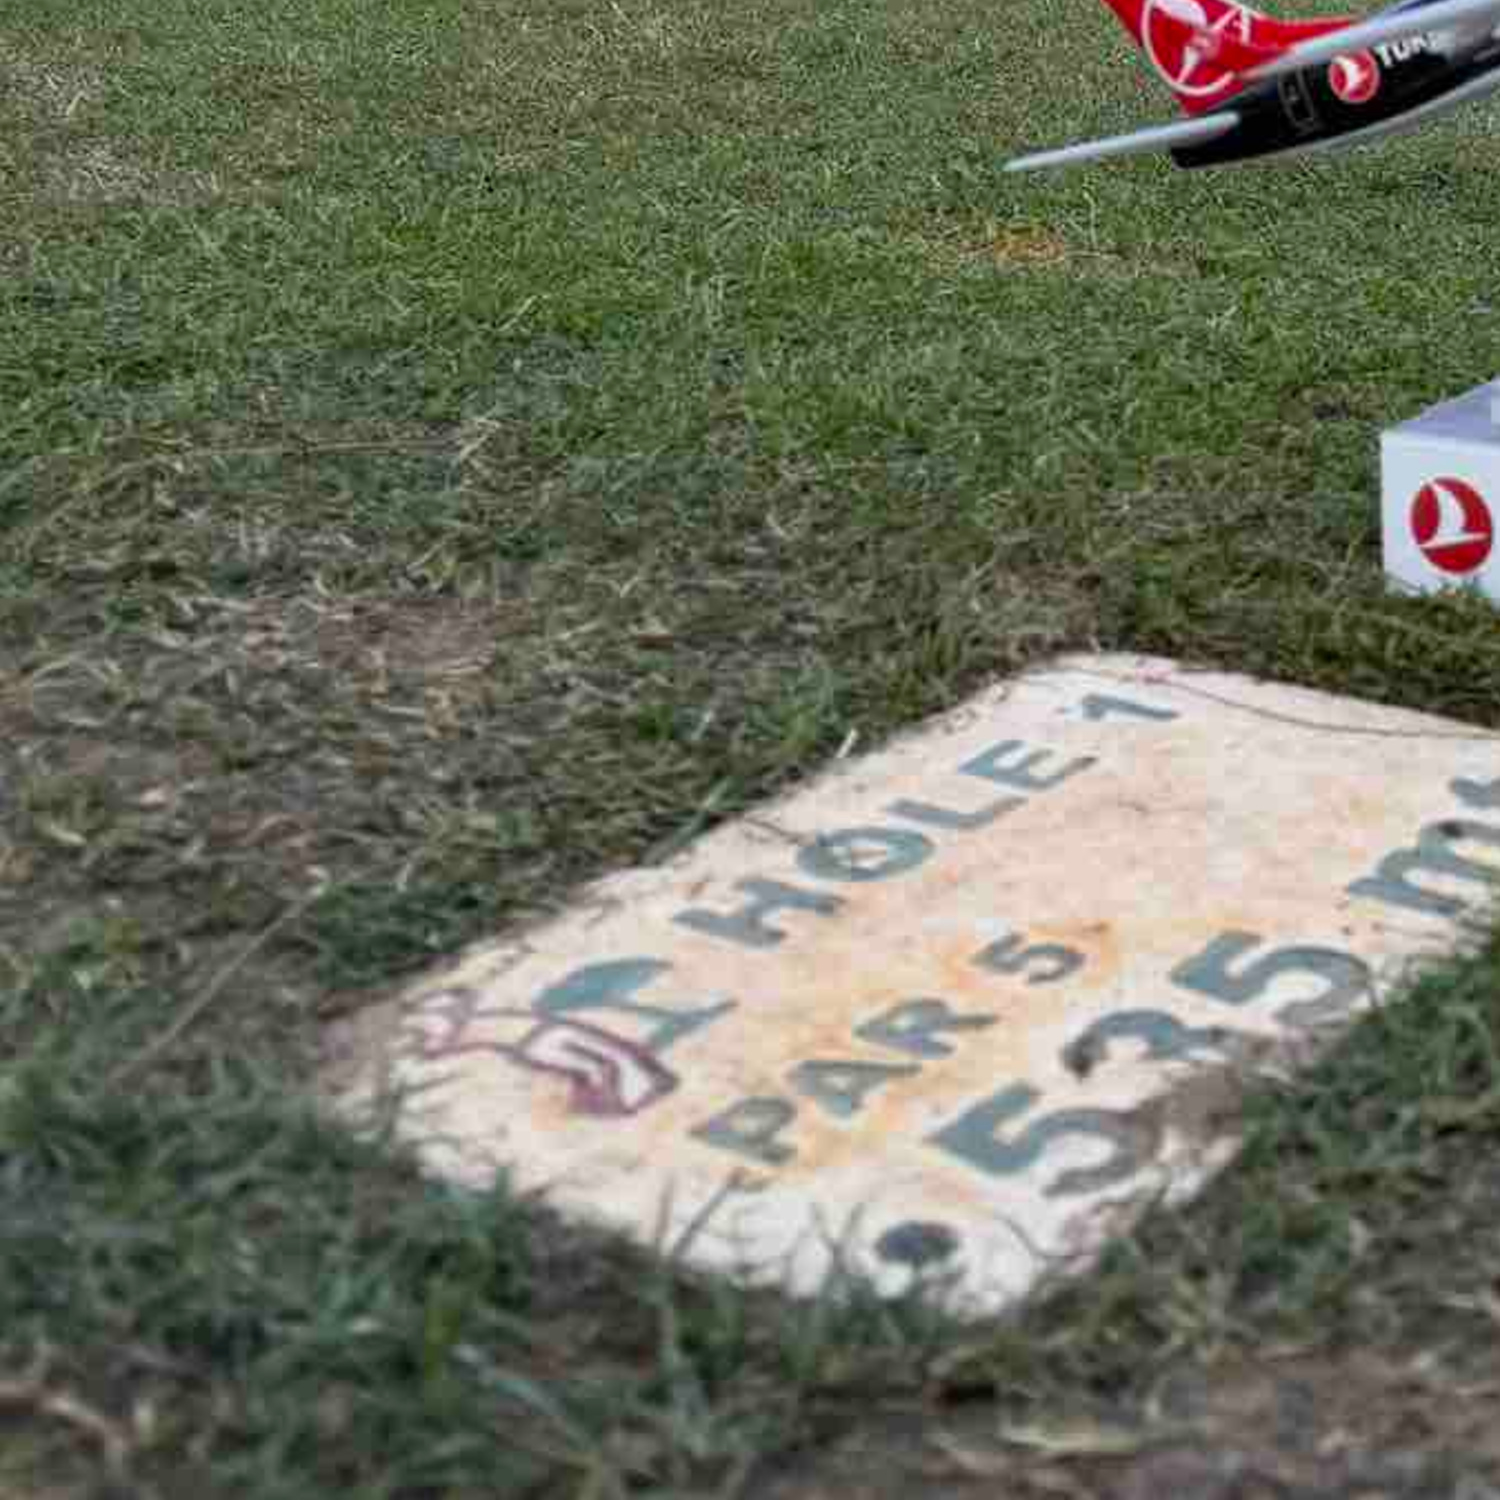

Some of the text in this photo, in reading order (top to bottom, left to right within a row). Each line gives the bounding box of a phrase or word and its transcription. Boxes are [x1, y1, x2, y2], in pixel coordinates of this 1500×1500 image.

[674, 688, 1178, 950] HOLE 1
[690, 933, 1088, 1167] PAR 5
[924, 930, 1377, 1198] 535
